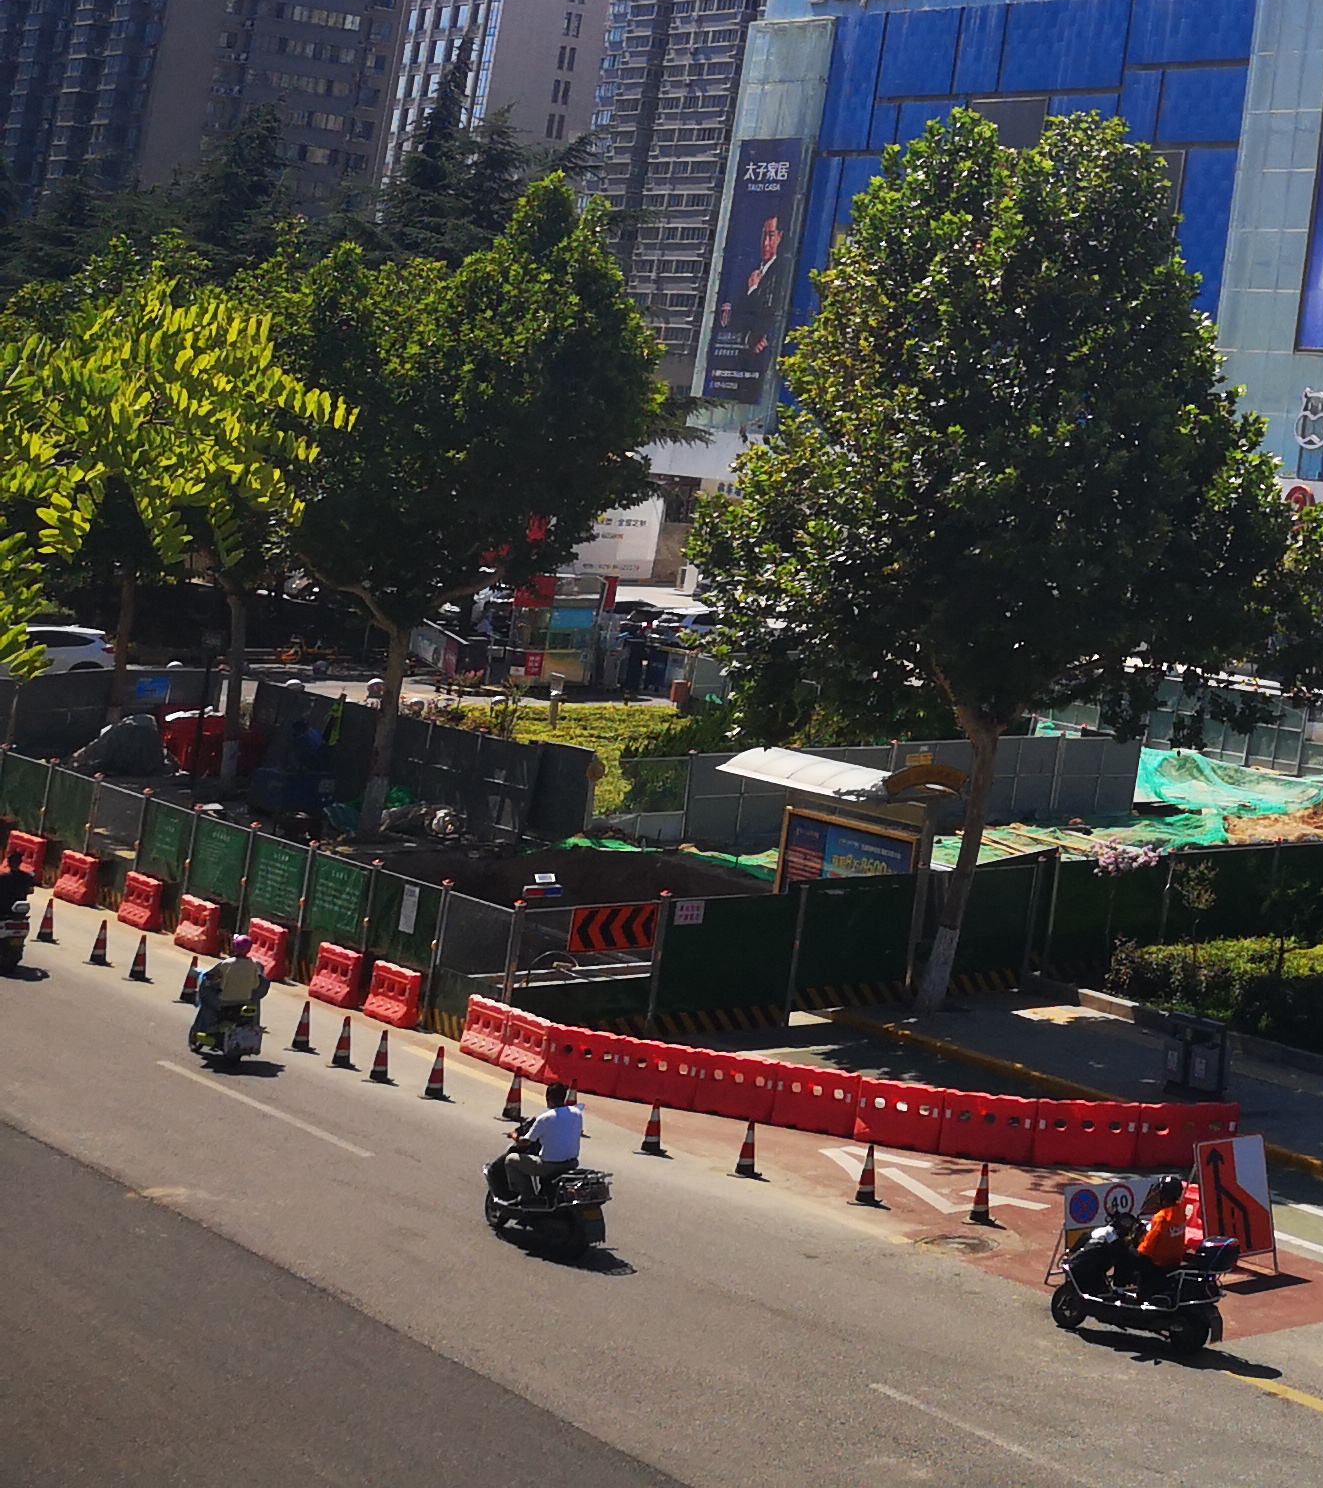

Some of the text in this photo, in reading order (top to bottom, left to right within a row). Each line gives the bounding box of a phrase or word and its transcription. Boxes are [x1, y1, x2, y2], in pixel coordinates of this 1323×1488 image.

[744, 162, 790, 181] 太子家居
[1111, 1194, 1129, 1210] 40
